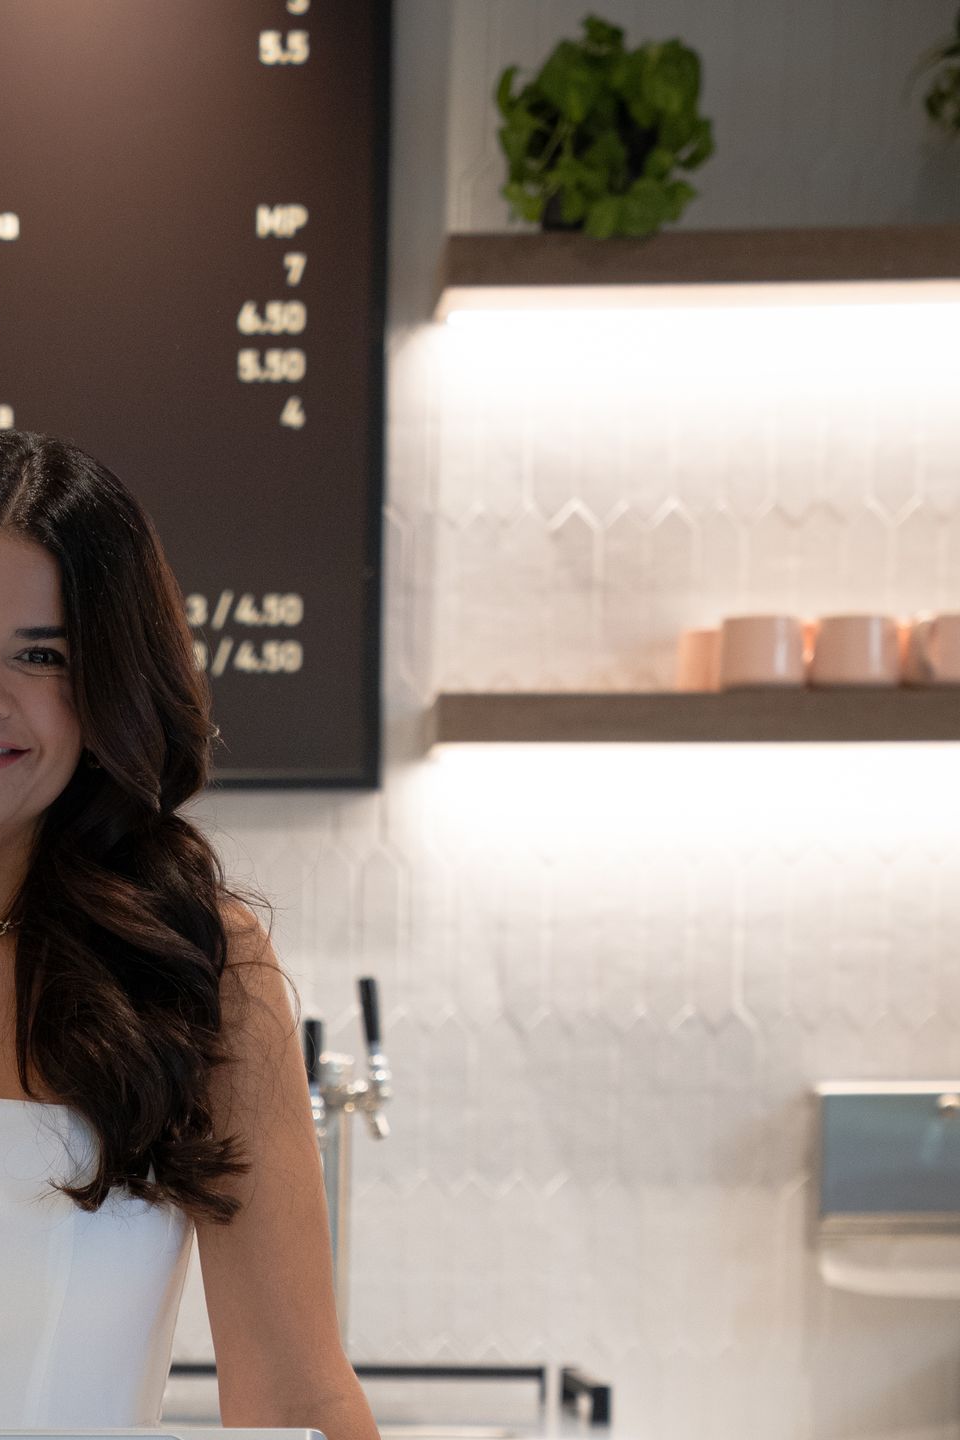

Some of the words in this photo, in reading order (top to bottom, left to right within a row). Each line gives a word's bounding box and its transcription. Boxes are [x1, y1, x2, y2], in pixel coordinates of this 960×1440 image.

[258, 30, 310, 65] 5.5
[255, 204, 309, 238] MP
[283, 253, 307, 286] 7
[237, 301, 307, 334] 6.50
[237, 349, 306, 382] 5.50
[279, 398, 305, 429] 4
